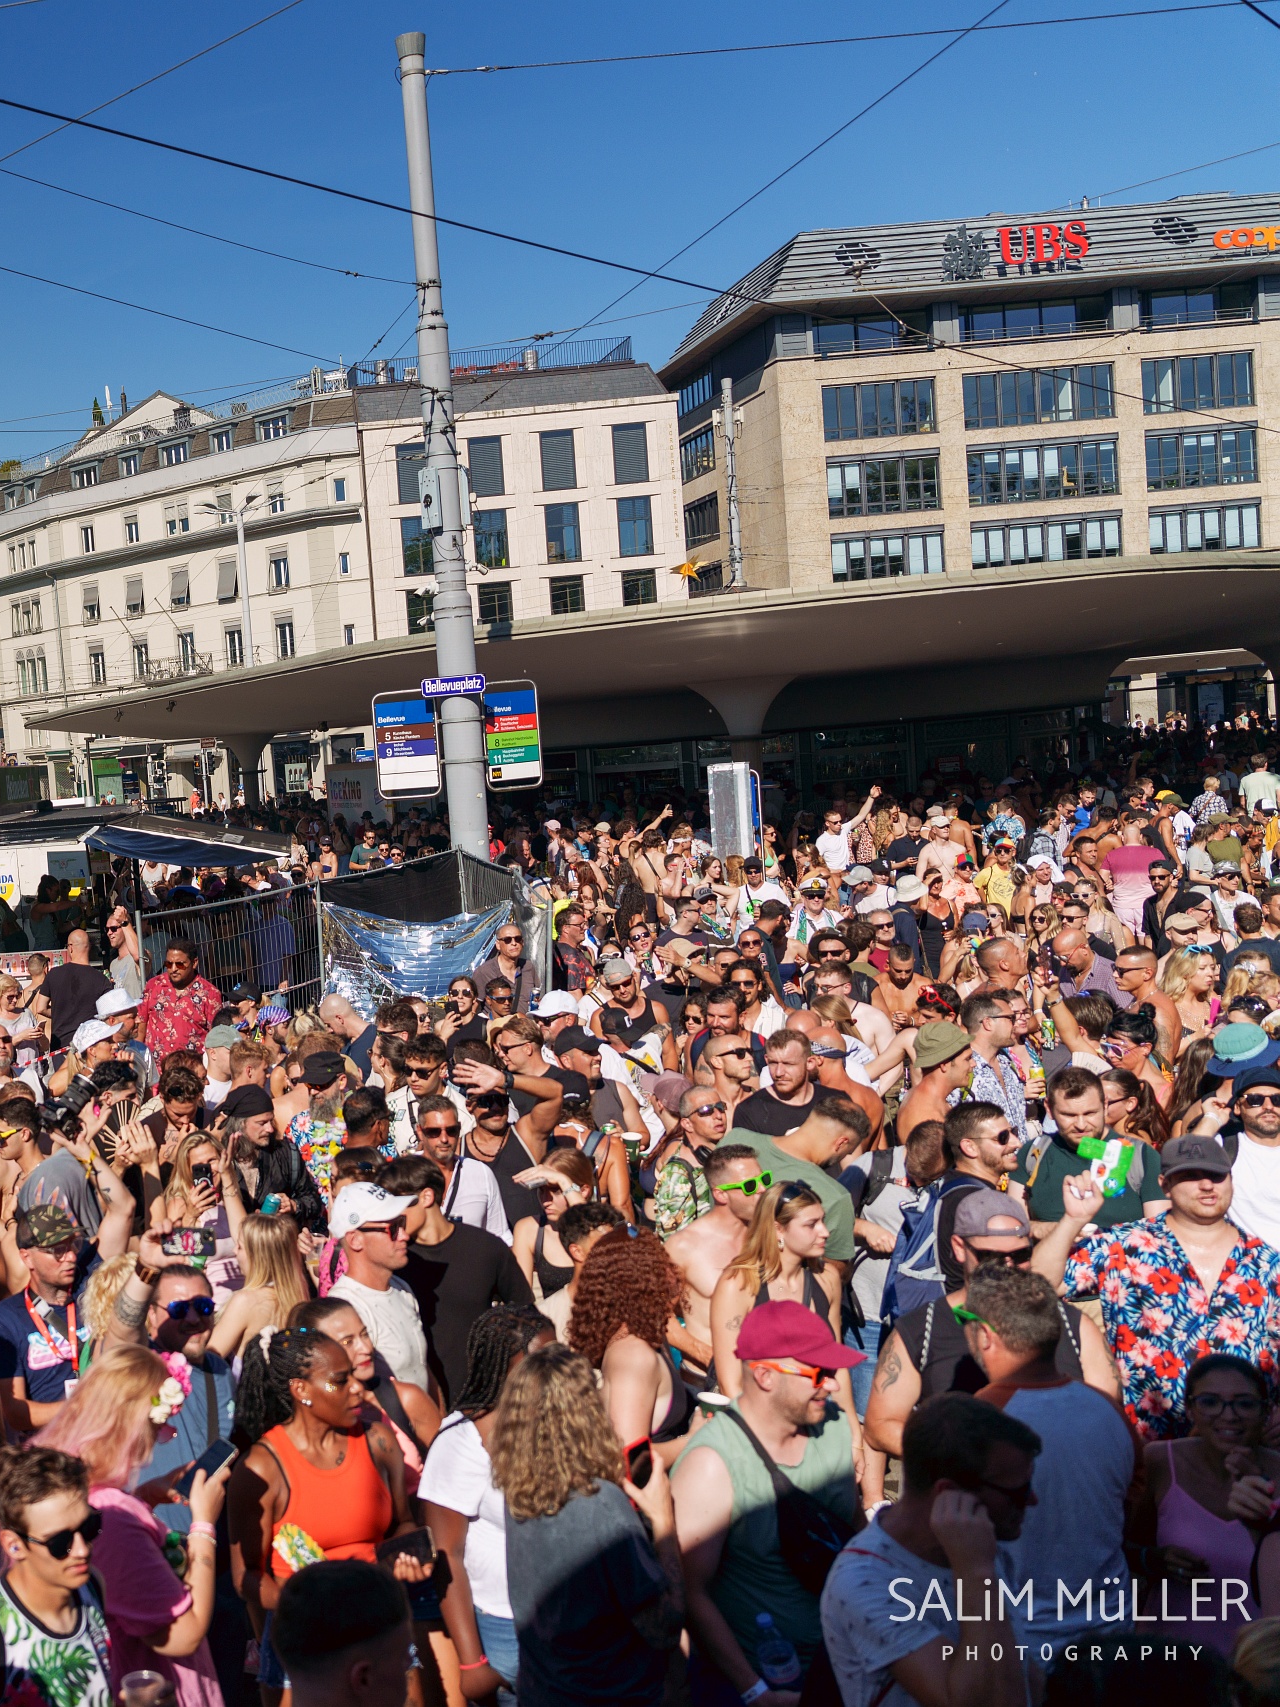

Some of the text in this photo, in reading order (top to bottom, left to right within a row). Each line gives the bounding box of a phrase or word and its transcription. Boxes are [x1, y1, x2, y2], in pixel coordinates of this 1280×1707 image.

[996, 220, 1089, 265] UBS
[425, 676, 482, 693] Bellevueplatz
[377, 716, 406, 724] Bellevue
[494, 723, 500, 732] 2
[385, 732, 391, 740] 5
[495, 739, 500, 747] 8
[493, 755, 501, 763] 11
